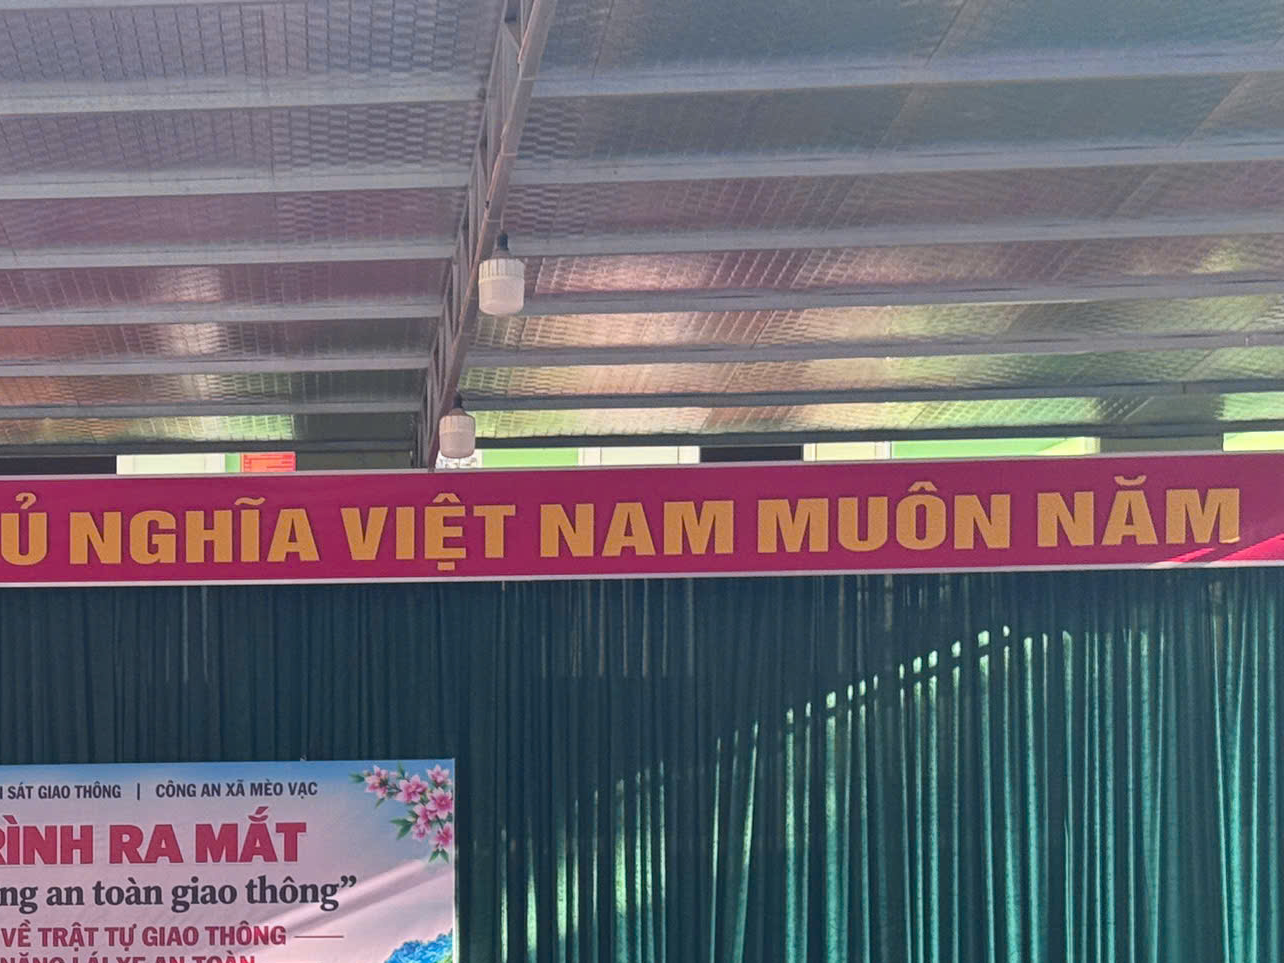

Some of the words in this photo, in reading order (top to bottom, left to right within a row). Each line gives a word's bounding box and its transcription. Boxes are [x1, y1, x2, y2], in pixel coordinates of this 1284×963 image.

[69, 497, 318, 565] NGHĨA
[342, 491, 515, 572] VIỆT
[538, 503, 734, 557] NAM
[758, 483, 1011, 554] MUÔN
[1037, 475, 1241, 547] NĂM
[7, 783, 34, 799] SÁT
[38, 785, 70, 799] GIAO
[75, 781, 121, 799] THÔNG
[156, 780, 196, 798] CÔNG
[201, 784, 221, 797] AN
[226, 781, 245, 797] XÃ
[250, 780, 283, 797] MÈO
[288, 781, 318, 799] VẠC
[109, 823, 184, 864] RA
[195, 806, 307, 863] MẮT
[46, 885, 85, 906] an
[93, 877, 163, 906] toàn
[171, 877, 237, 913] giao
[245, 875, 357, 911] thông”
[0, 920, 31, 947] VỀ
[38, 922, 98, 951] TRẬT
[105, 923, 137, 951] TỰ
[142, 925, 199, 947] GIAO
[205, 920, 286, 946] THÔNG
